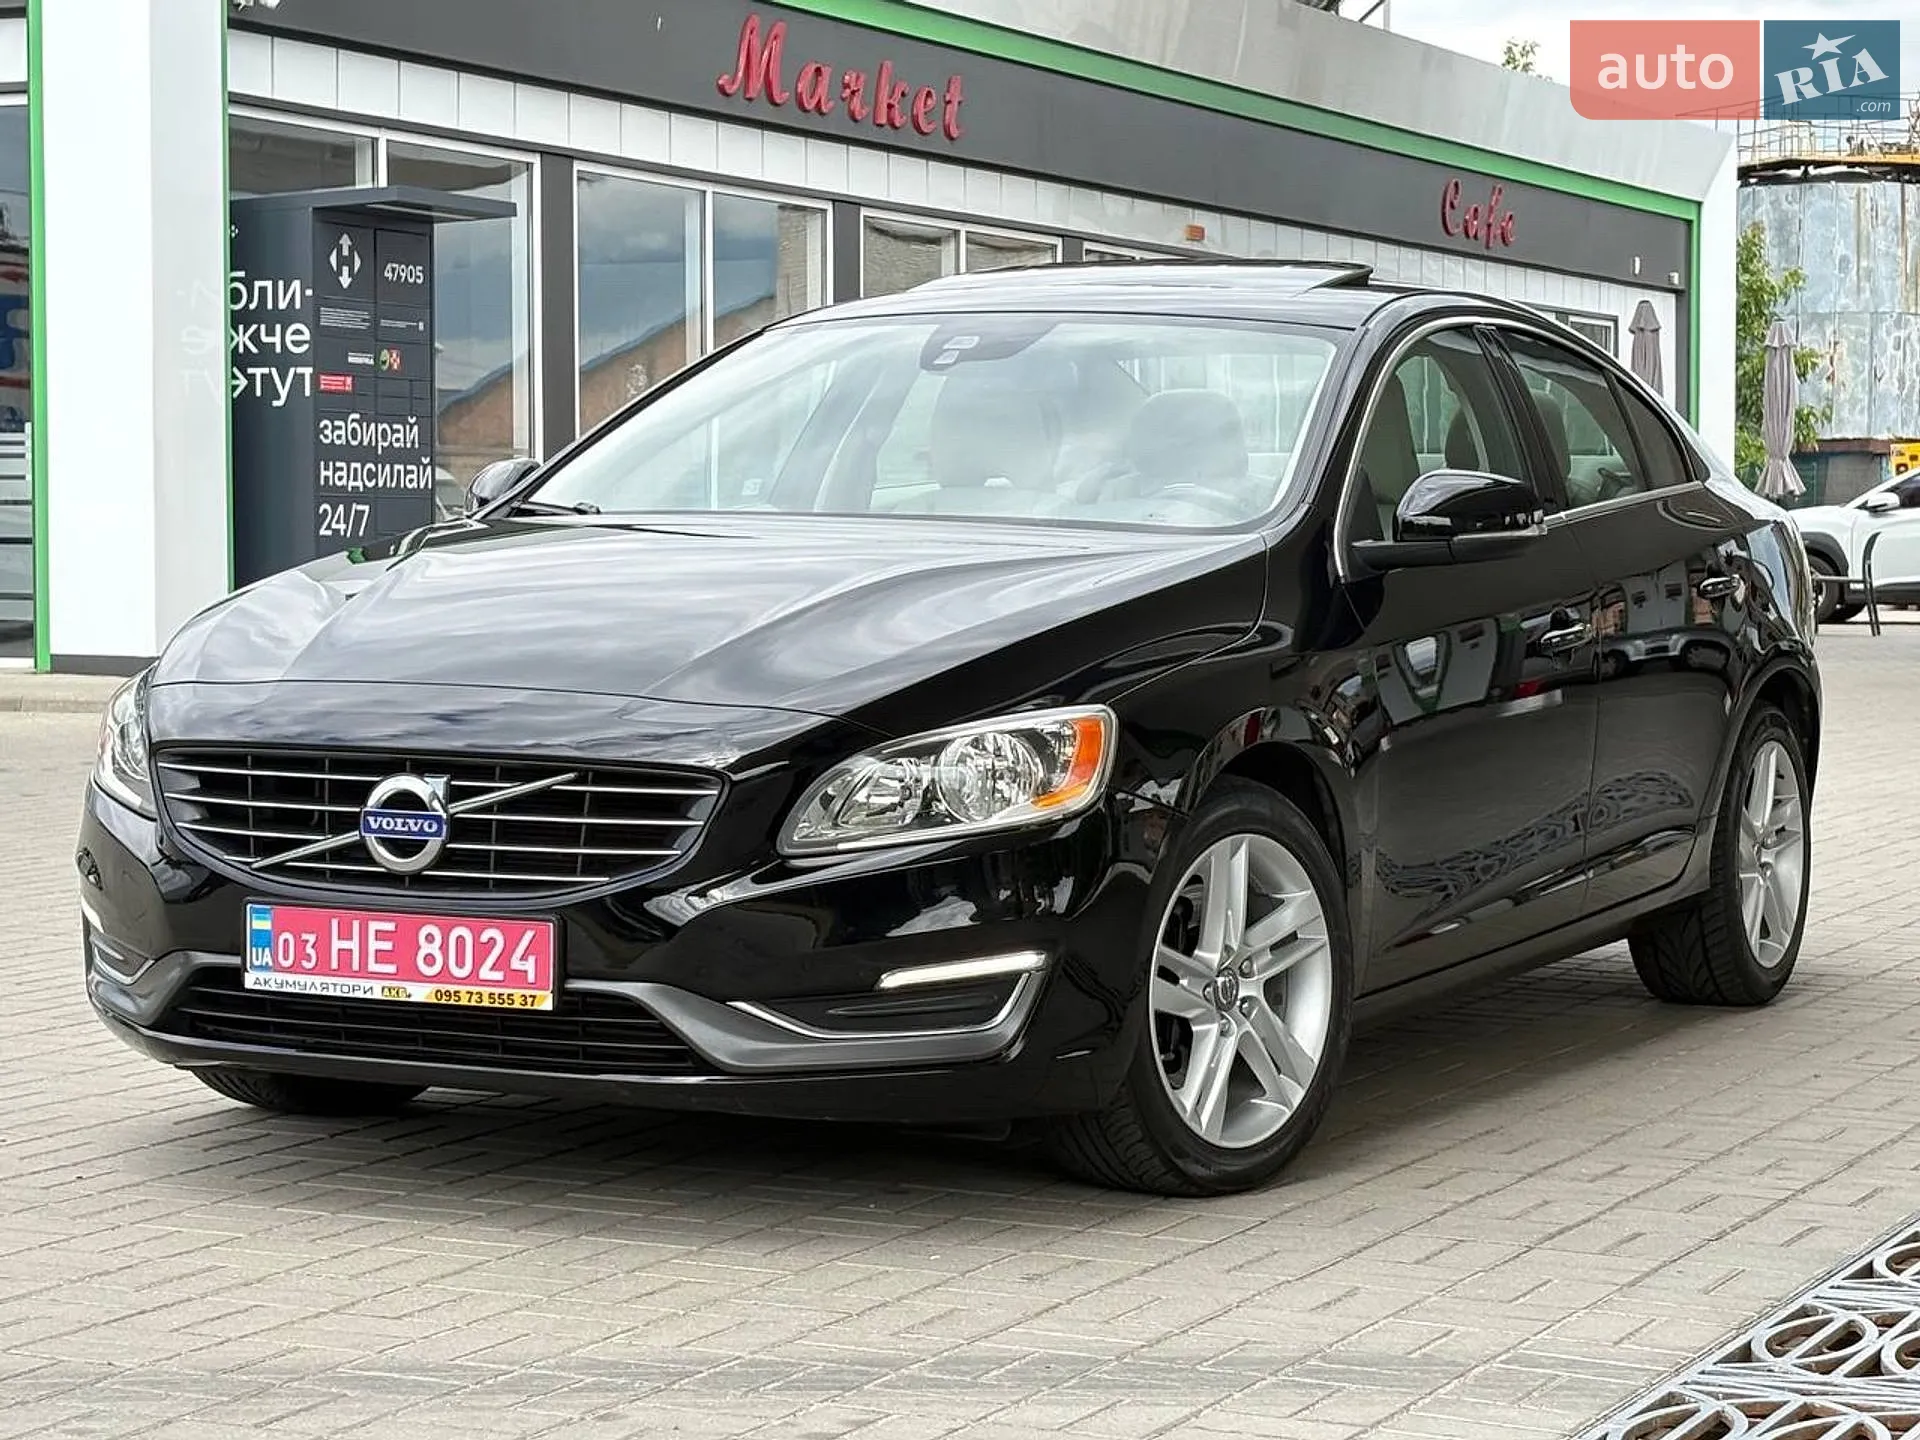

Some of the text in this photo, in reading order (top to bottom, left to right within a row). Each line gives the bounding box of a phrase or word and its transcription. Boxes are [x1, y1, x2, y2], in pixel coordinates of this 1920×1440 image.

[716, 13, 965, 141] Market
[1441, 178, 1518, 250] Cafe
[384, 262, 425, 284] 47905
[246, 366, 313, 407] тут
[319, 413, 419, 454] забирай
[319, 457, 432, 491] надсилай
[319, 503, 370, 537] 24/7
[366, 815, 438, 833] VOLVO
[252, 948, 273, 967] UA
[276, 918, 537, 985] 03 HE 8024
[252, 976, 374, 996] АКУМУЛЯТОРИ
[434, 989, 462, 1004] 095
[466, 990, 484, 1005] 73
[487, 991, 514, 1007] 555
[518, 993, 538, 1008] 37
